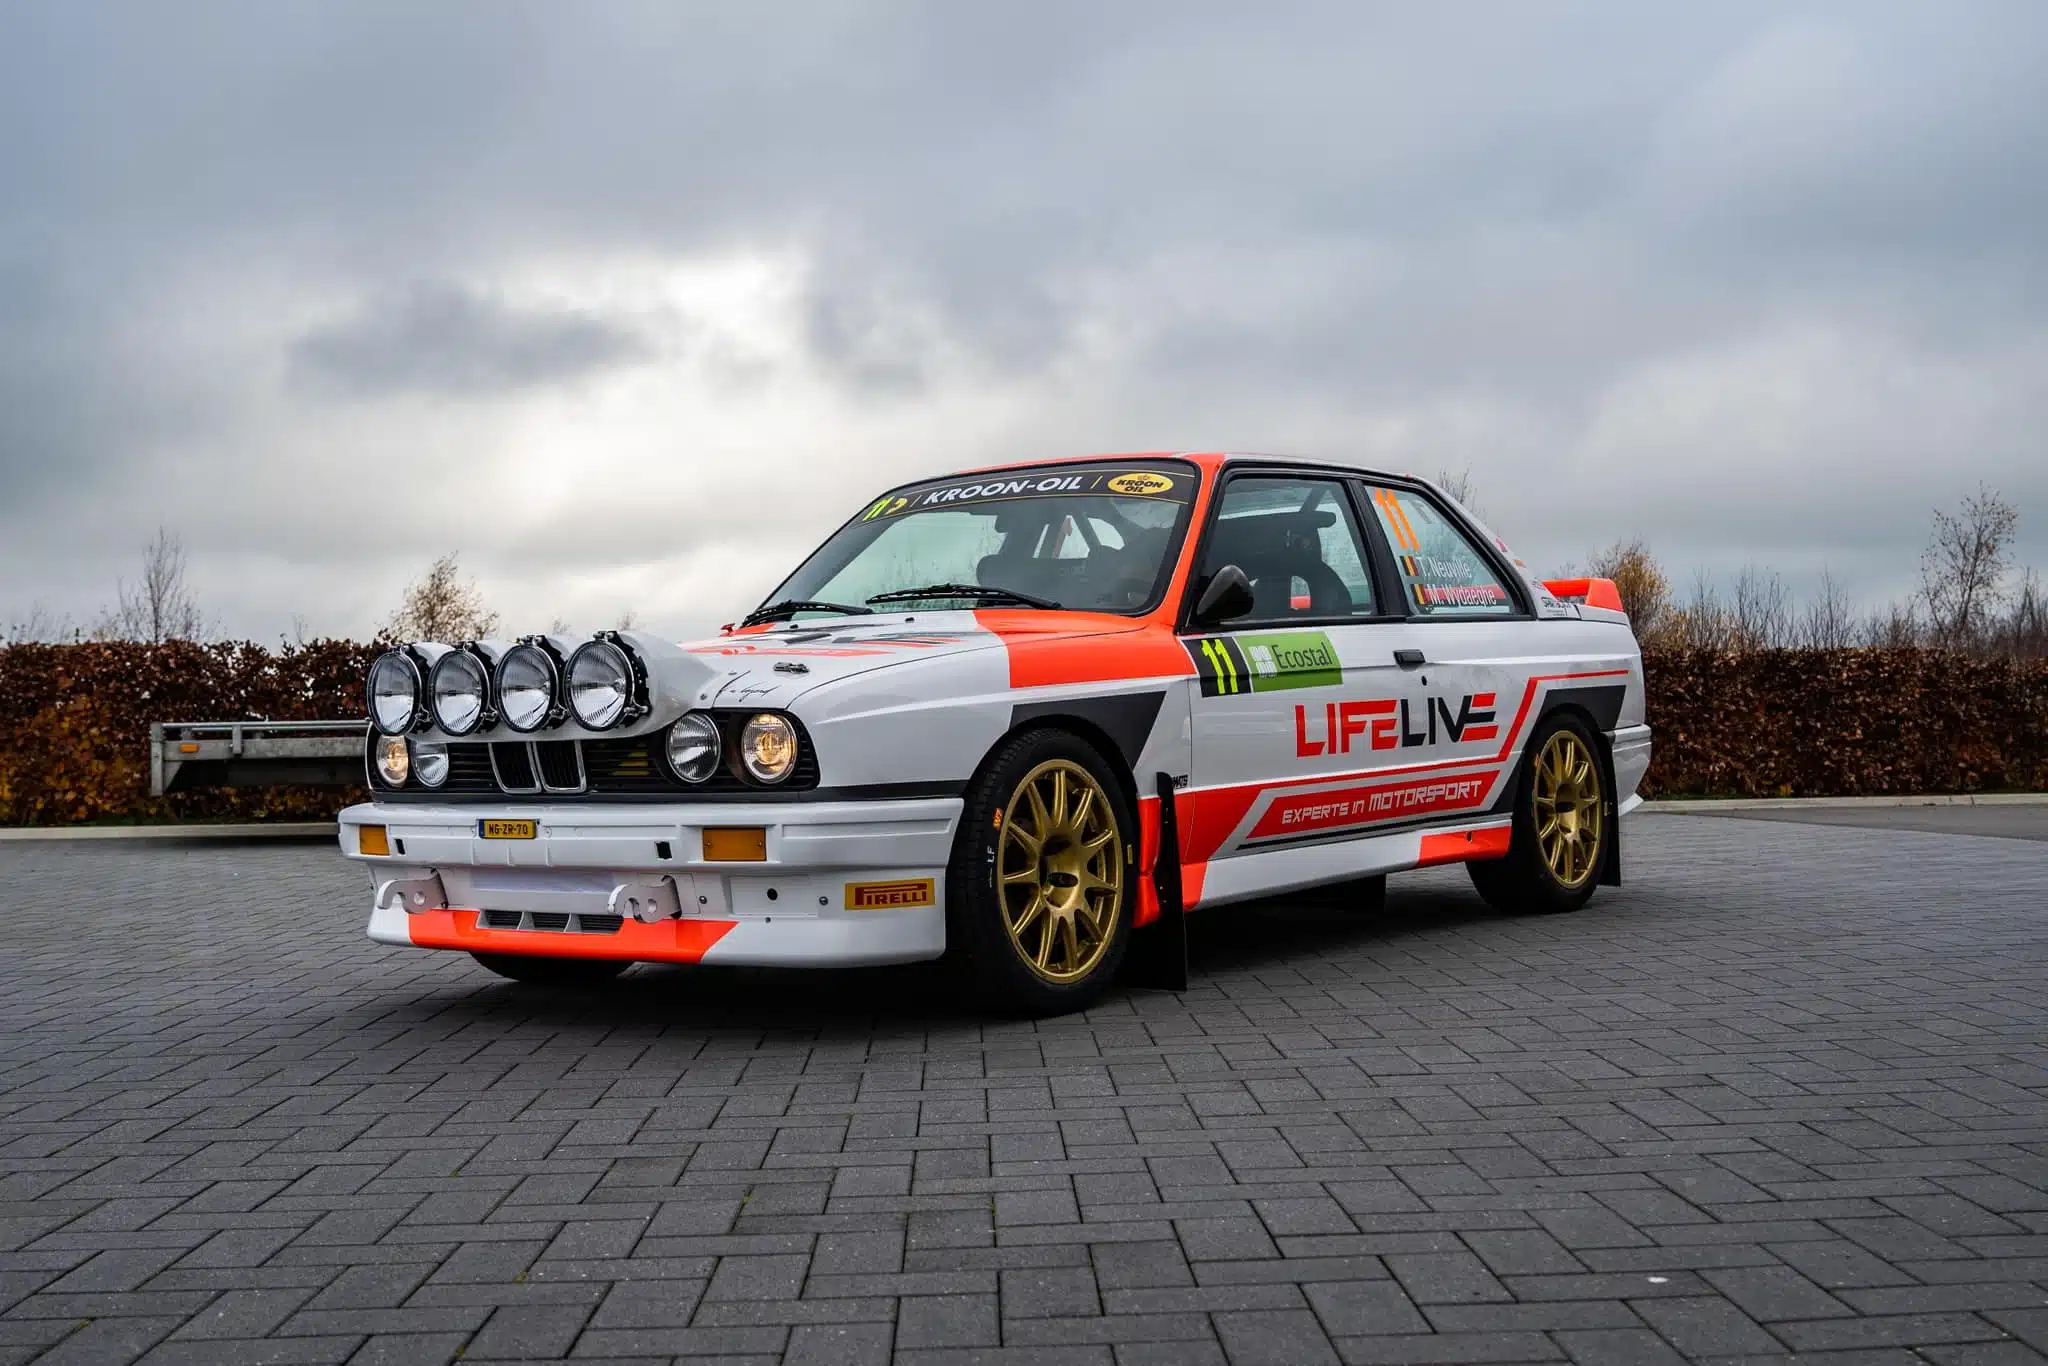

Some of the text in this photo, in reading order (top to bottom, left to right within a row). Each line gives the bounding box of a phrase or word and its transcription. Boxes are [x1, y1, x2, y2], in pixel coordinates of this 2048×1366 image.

[922, 476, 1083, 505] KROON-OIL
[1116, 479, 1164, 488] KROON
[1375, 487, 1420, 551] 11
[1428, 556, 1472, 578] Neuville
[1201, 639, 1238, 694] 11
[1271, 641, 1332, 669] Ecostal
[1295, 692, 1499, 758] LIFELIVE
[1282, 801, 1350, 824] EXPERTS
[1369, 780, 1481, 812] MOTORSPORT
[855, 883, 927, 905] PIRELLI
